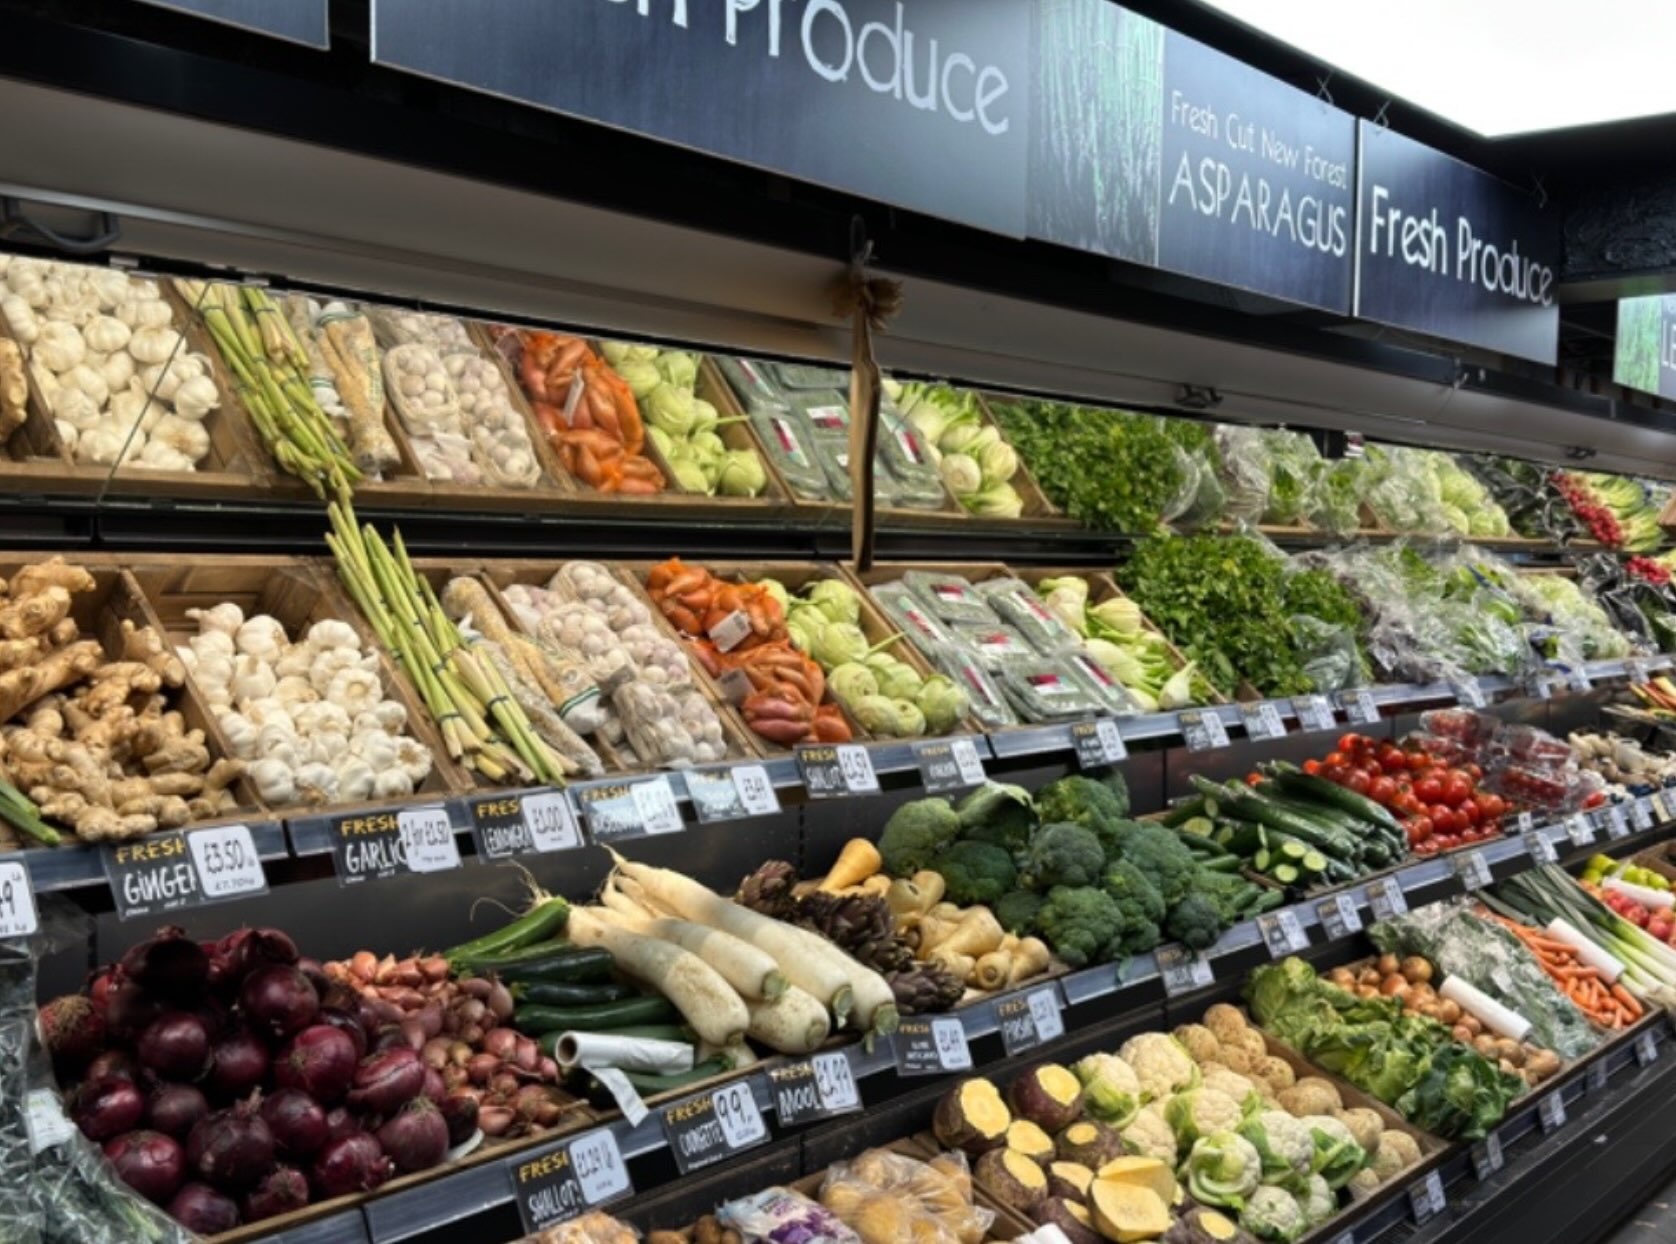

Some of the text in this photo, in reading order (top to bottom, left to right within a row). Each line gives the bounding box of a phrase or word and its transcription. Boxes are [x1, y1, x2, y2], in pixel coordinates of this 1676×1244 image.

[1172, 90, 1347, 190] Fresh Cut New Forest
[1168, 150, 1347, 257] ASPARAGUS
[1370, 185, 1553, 306] Fresh Produce
[477, 800, 520, 819] FRES
[716, 1088, 746, 1129] 99
